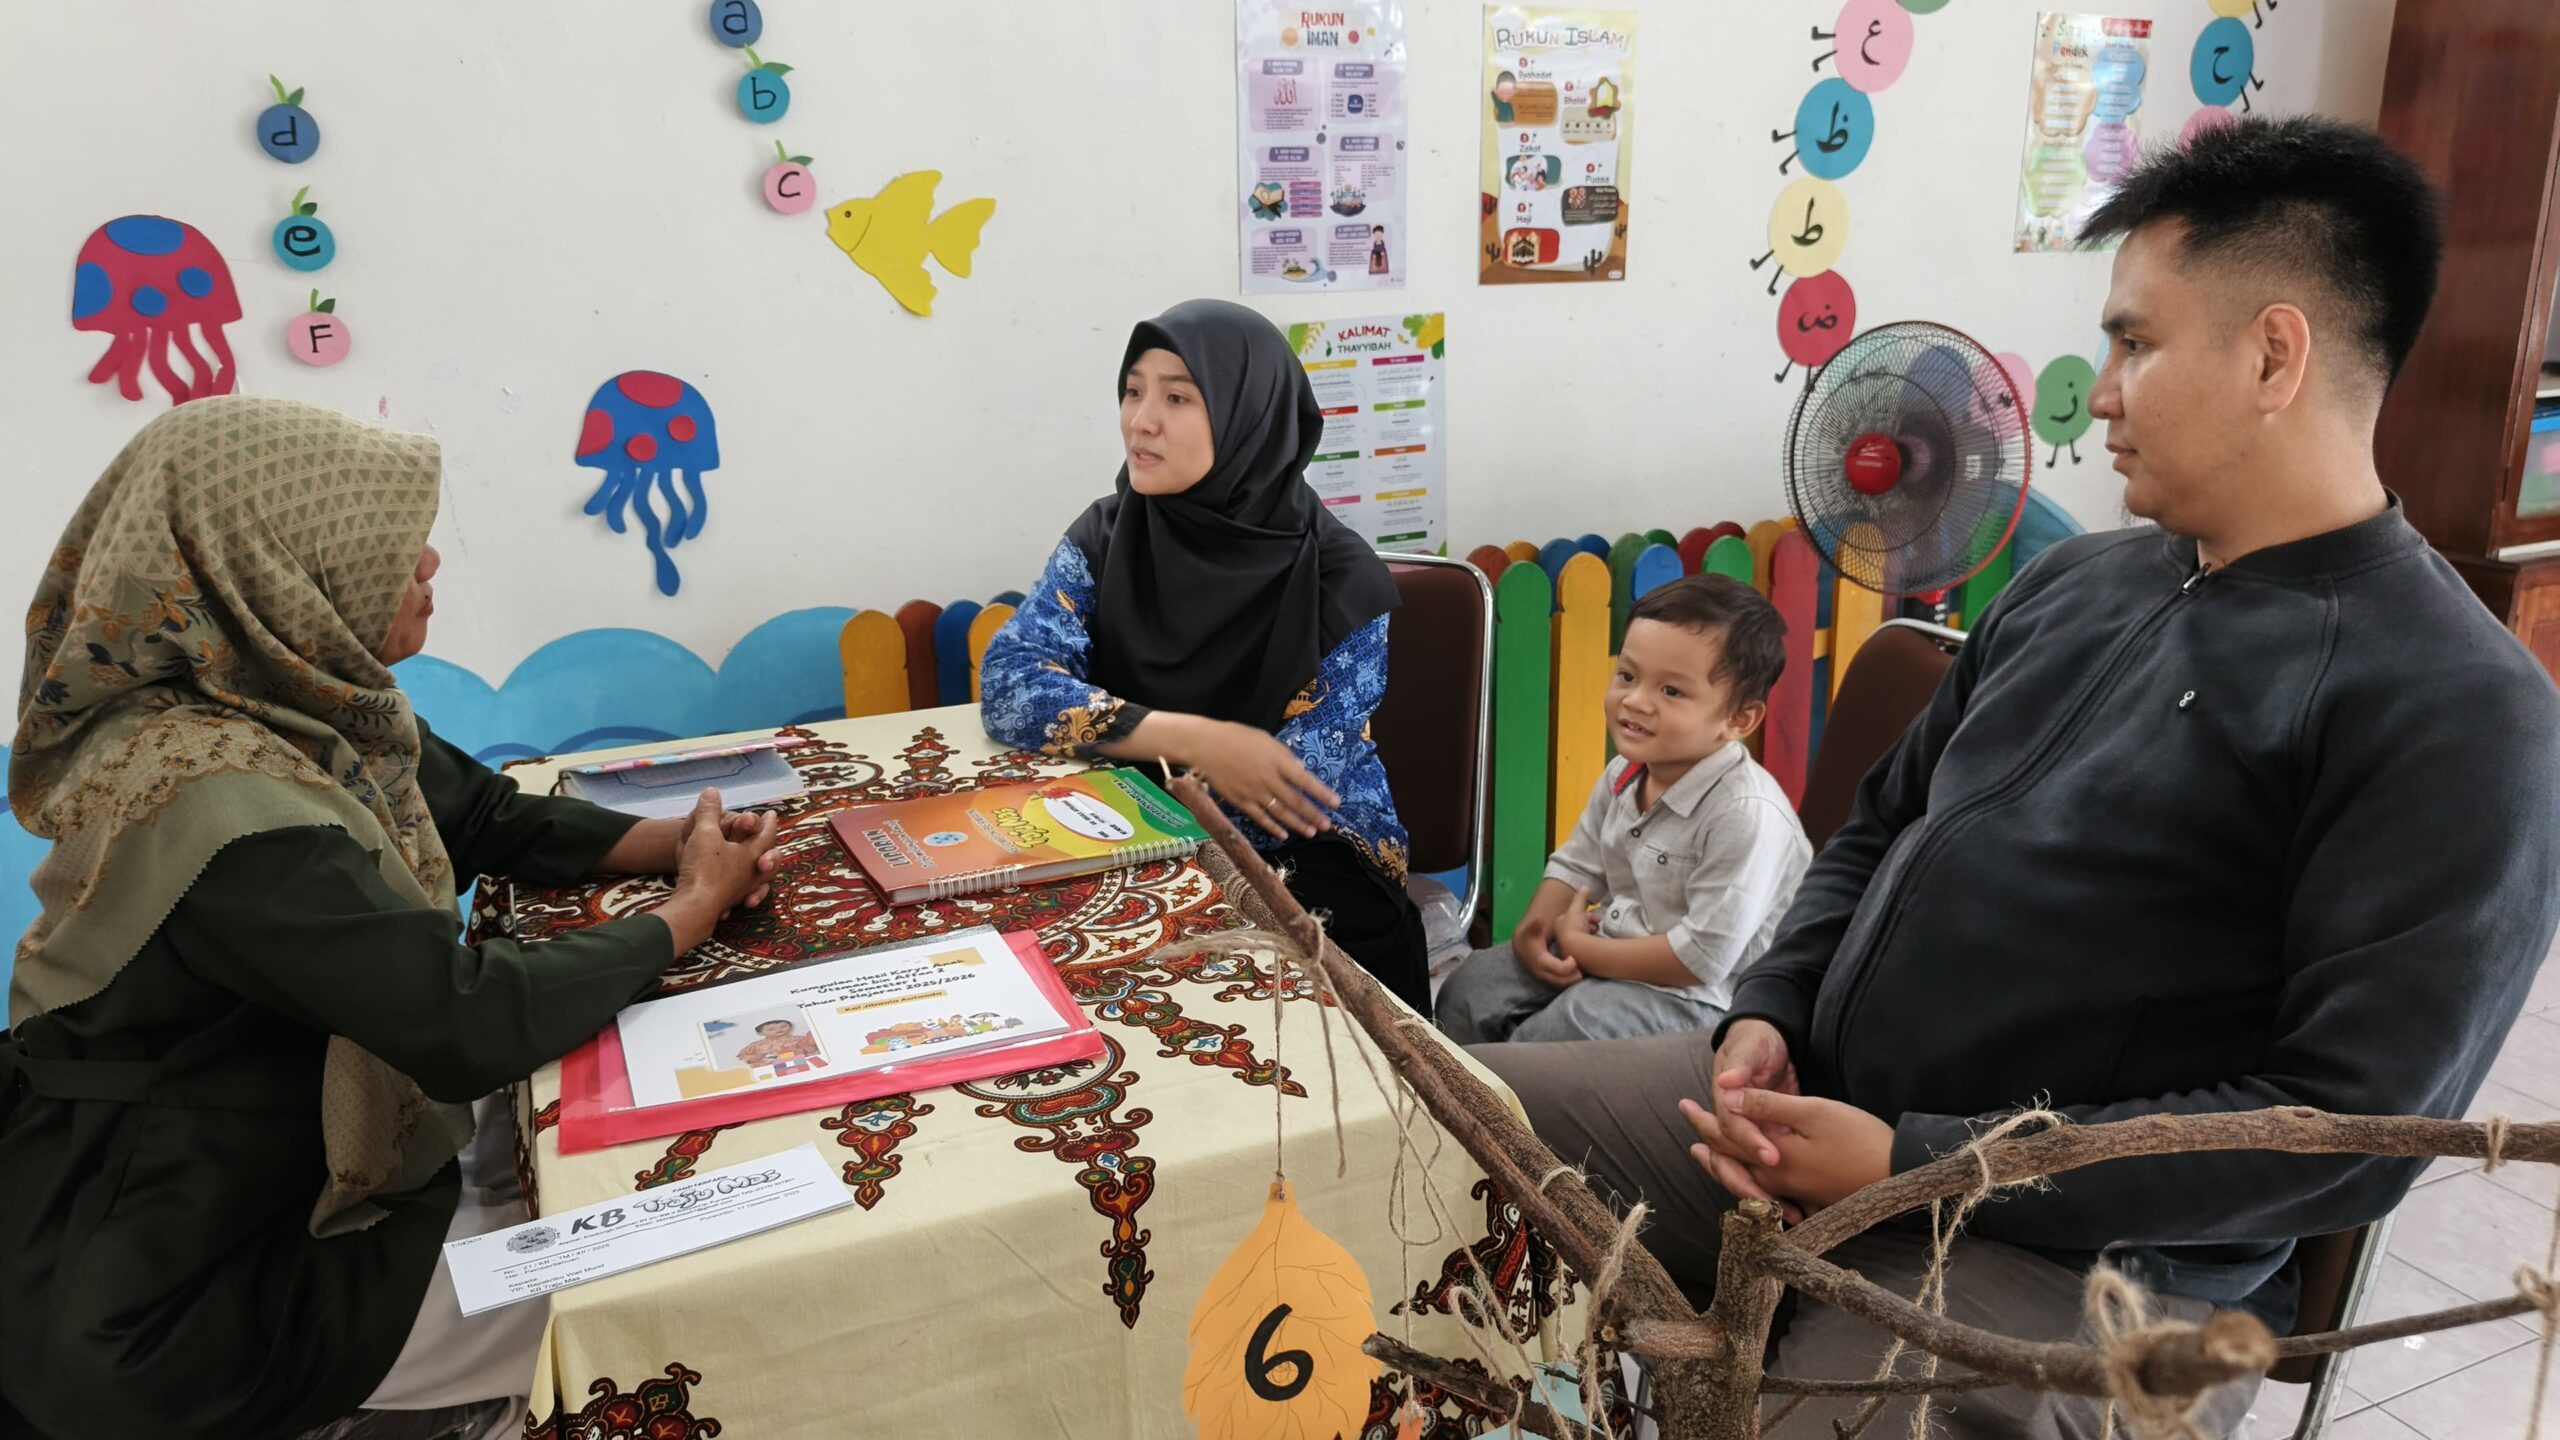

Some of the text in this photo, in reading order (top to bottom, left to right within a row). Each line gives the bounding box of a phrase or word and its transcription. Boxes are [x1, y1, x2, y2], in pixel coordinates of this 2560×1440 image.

[723, 1, 748, 35] a
[1301, 12, 1344, 28] RUKUN
[1307, 31, 1338, 46] IMAN
[1496, 28, 1559, 48] RUKUN
[1860, 20, 1882, 66] ع
[2212, 46, 2234, 84] ح
[751, 77, 776, 110] b
[271, 115, 298, 146] d
[1816, 101, 1849, 154] ظ
[1791, 197, 1823, 247] ط
[283, 225, 321, 257] e
[309, 324, 333, 353] F
[1337, 325, 1391, 342] KALIMAT
[1337, 342, 1391, 353] THAYYIBAH
[790, 959, 964, 994] Kumpulan Hasil Karya Anak
[796, 973, 975, 1008] Tahun Pelajaran 2025/2026
[849, 980, 907, 993] Semester
[572, 1208, 625, 1234] KB
[1245, 1303, 1314, 1401] 6
